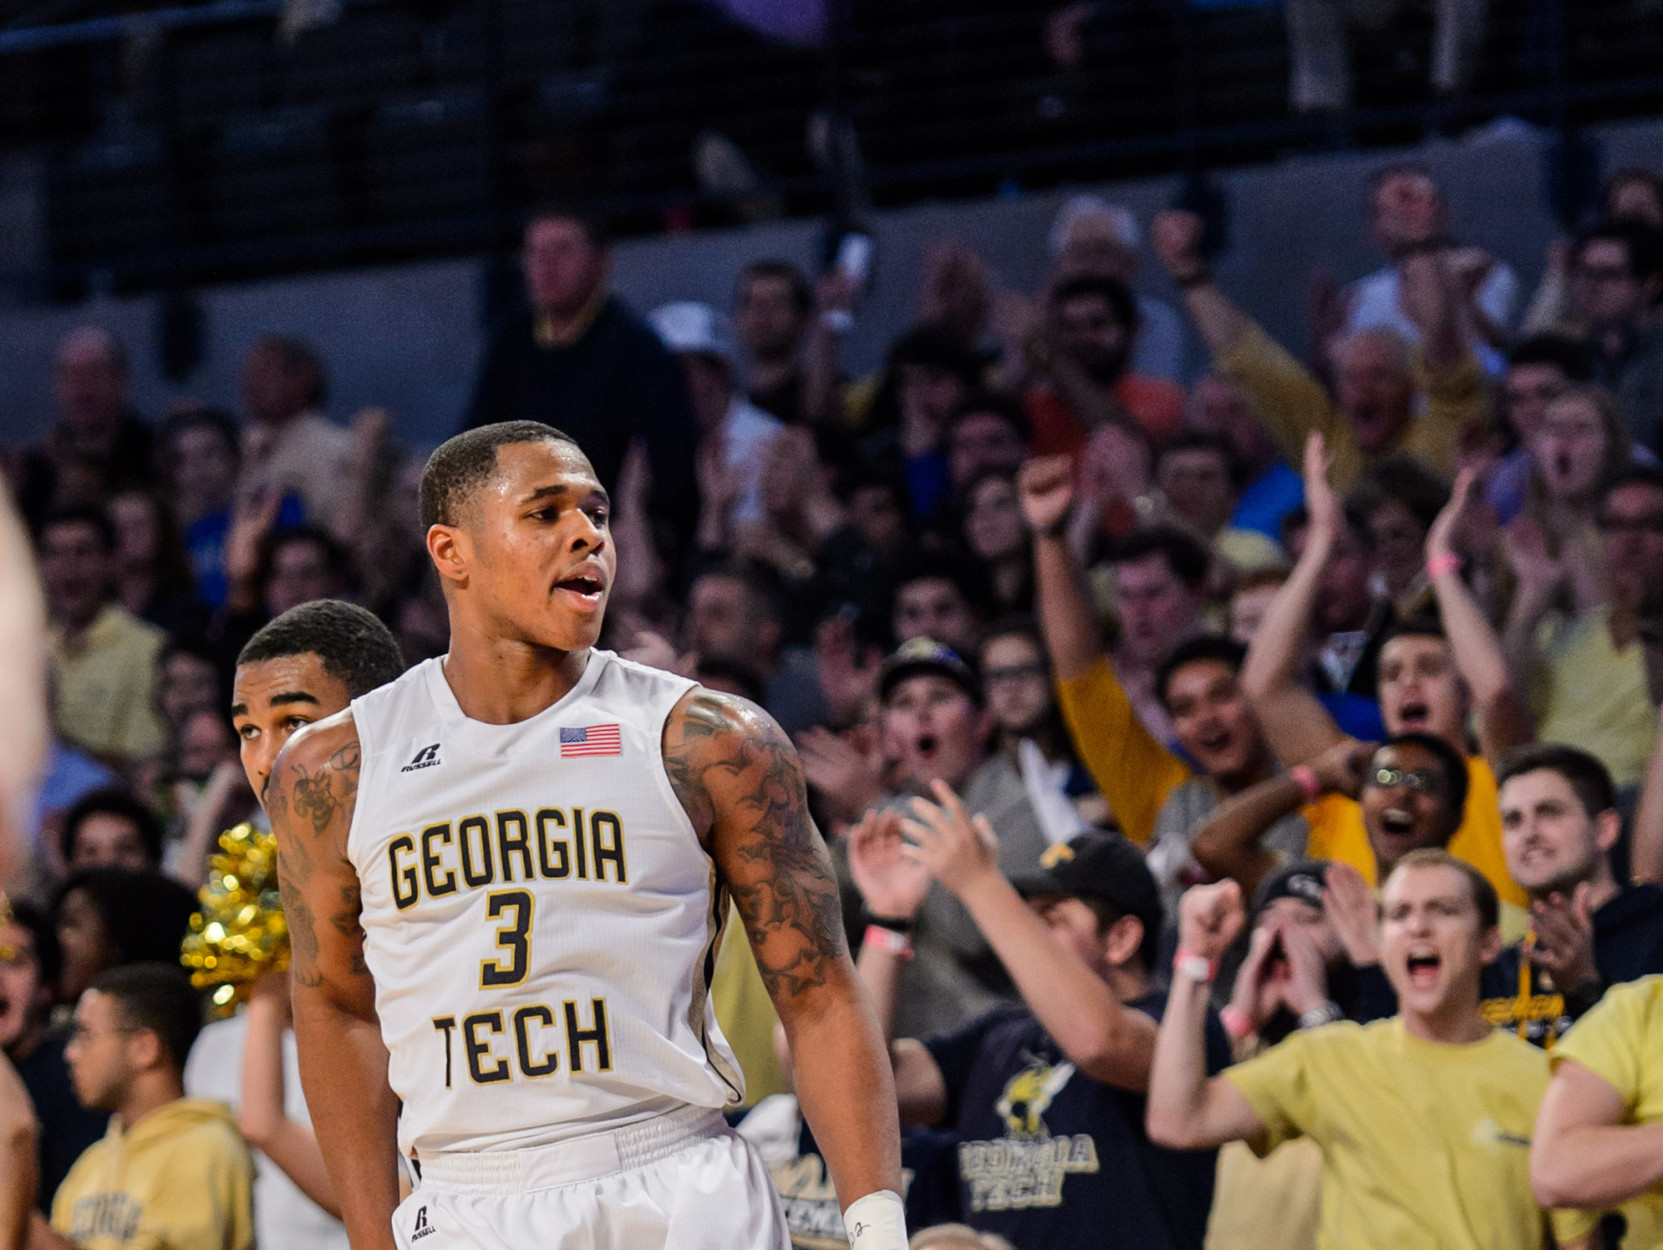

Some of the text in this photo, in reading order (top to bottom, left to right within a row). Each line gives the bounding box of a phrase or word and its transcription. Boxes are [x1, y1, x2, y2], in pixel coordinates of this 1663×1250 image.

[401, 759, 442, 773] RUSSELL
[387, 806, 629, 912] GEORGIA
[478, 887, 536, 991] 3
[432, 997, 614, 1090] TECH
